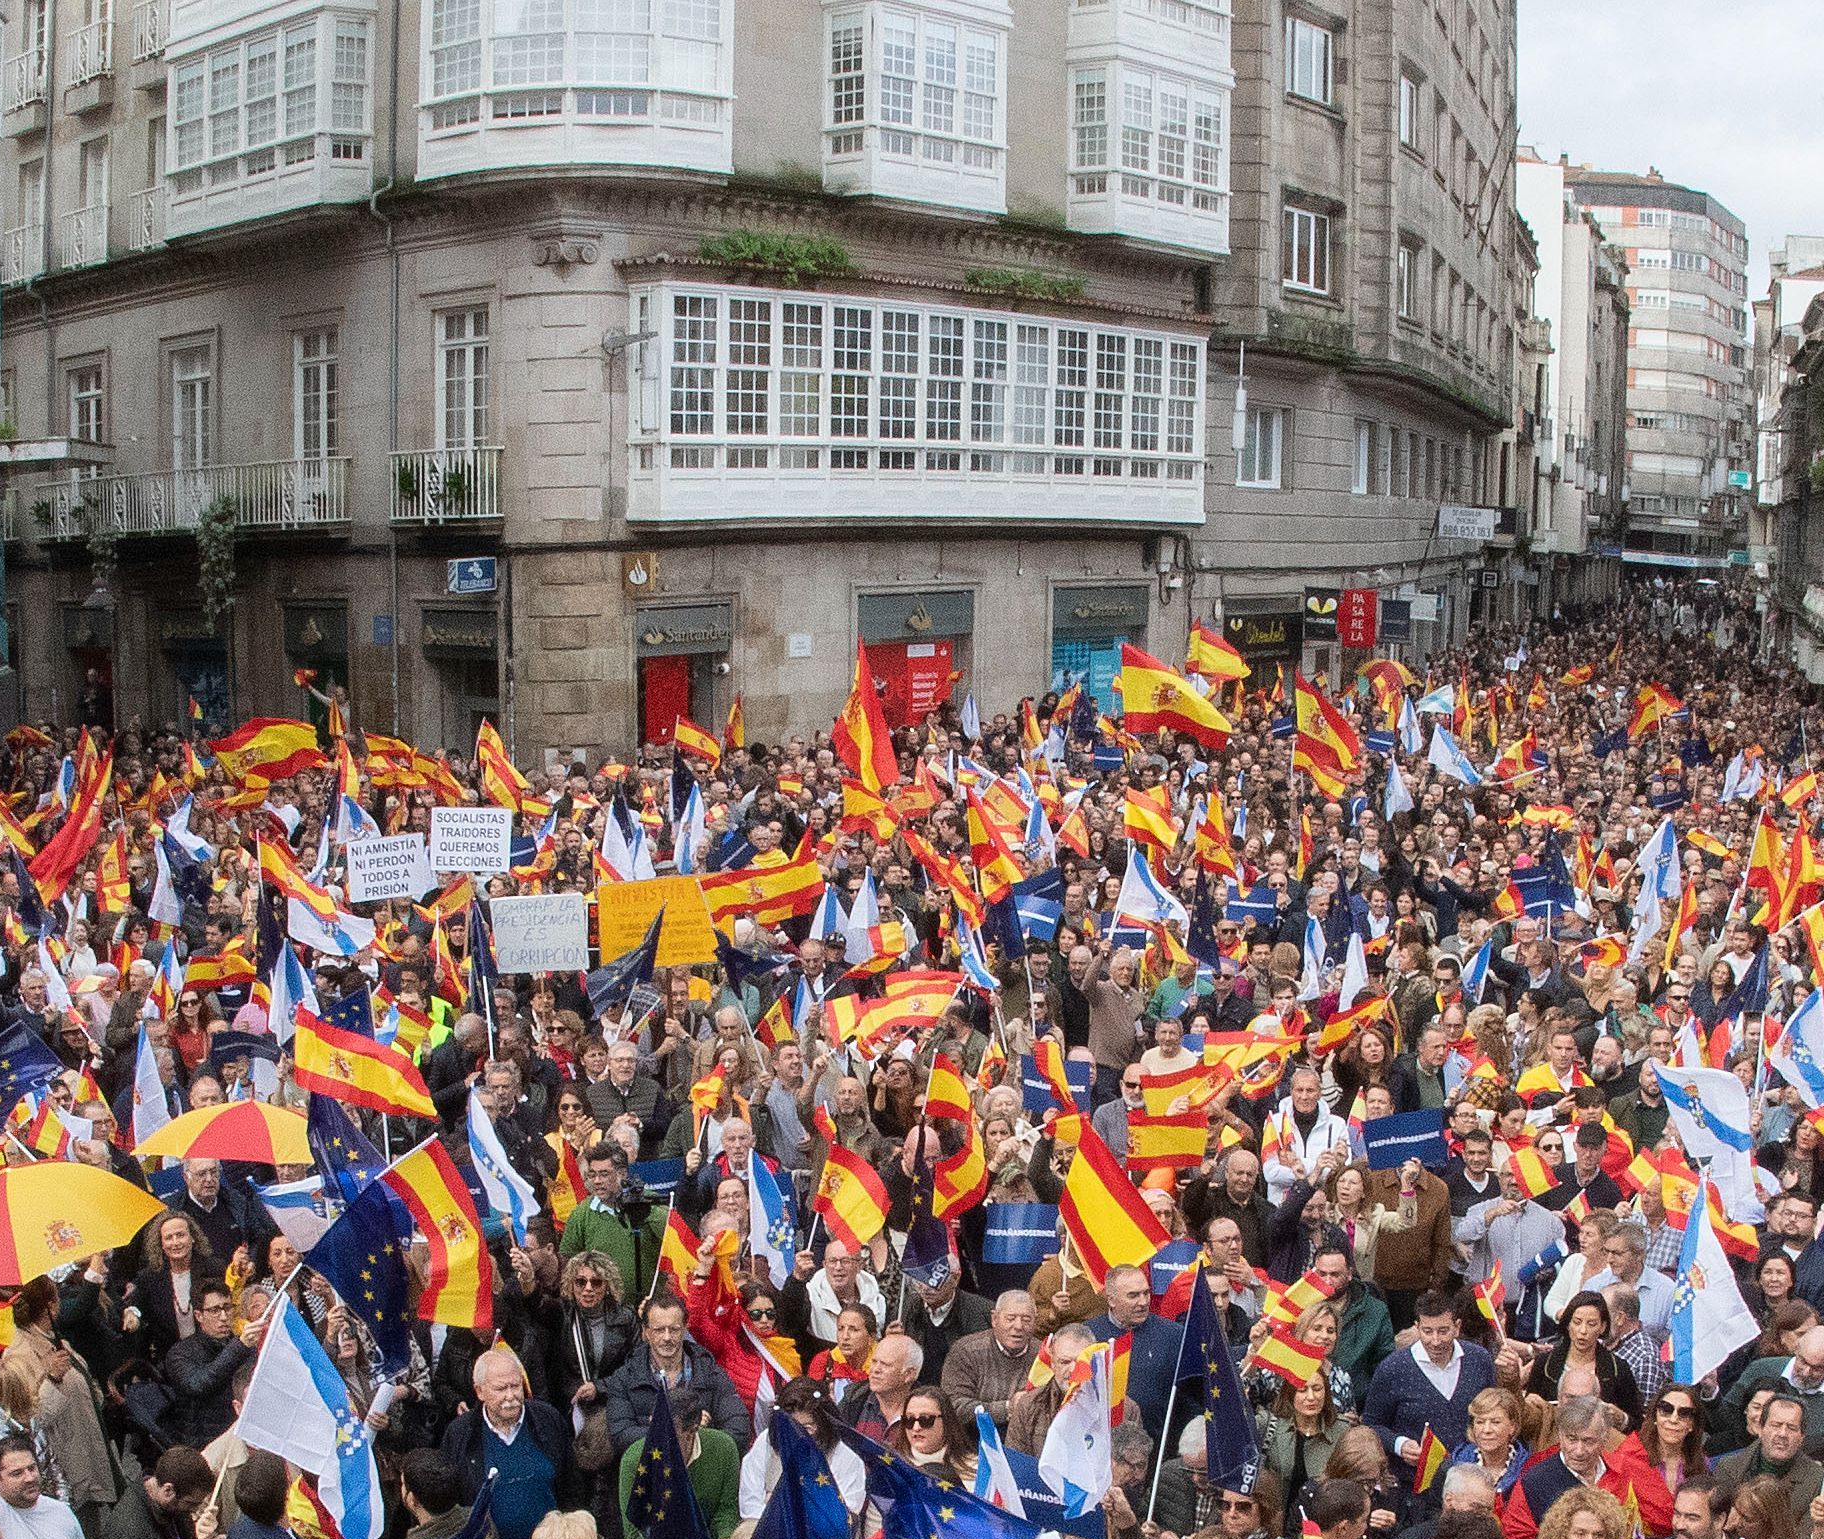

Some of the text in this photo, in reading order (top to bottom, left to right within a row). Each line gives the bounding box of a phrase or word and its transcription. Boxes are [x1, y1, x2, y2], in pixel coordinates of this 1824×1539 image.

[436, 812, 506, 824] SOCIALISTAS
[440, 827, 501, 839] TRAIDORES
[351, 839, 417, 857] NI AMNISTÍA
[439, 842, 500, 853] QUEREMOS
[354, 853, 415, 871] NI PERDÓN
[435, 856, 503, 868] ELECCIONES
[362, 869, 410, 883] TODOS A
[364, 882, 409, 897] PRISIÓN
[558, 900, 576, 912] LA
[494, 912, 581, 928] PRESIDENCIA
[522, 928, 548, 942] ES
[498, 946, 587, 969] CORRUPCIÓN
